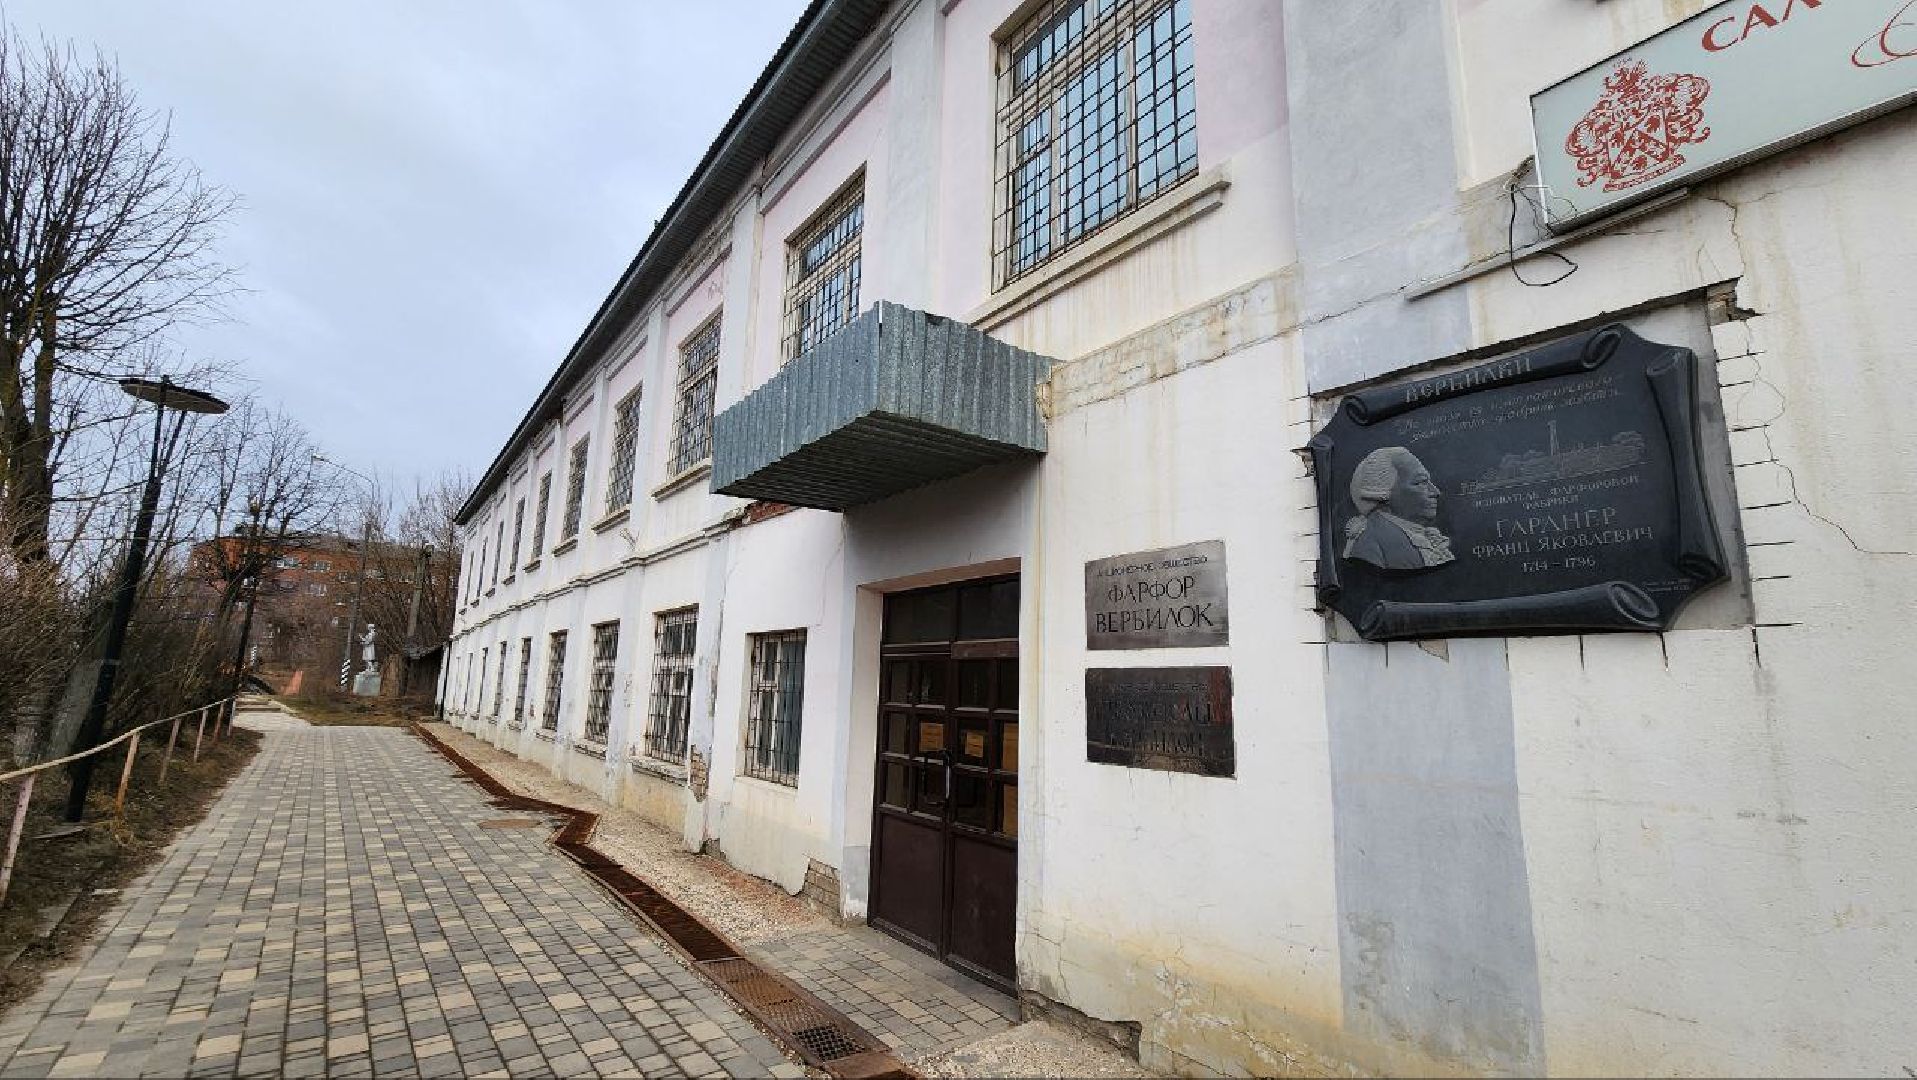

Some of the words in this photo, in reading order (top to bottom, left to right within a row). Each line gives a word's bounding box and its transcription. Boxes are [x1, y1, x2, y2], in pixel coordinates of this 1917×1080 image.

[1473, 539, 1531, 559] ФРАНЦ
[1538, 526, 1654, 552] ЯКОВЛЕВИЧ
[1108, 575, 1195, 603] ФАРФОР
[1096, 603, 1214, 633] ВЕРБИЛОК
